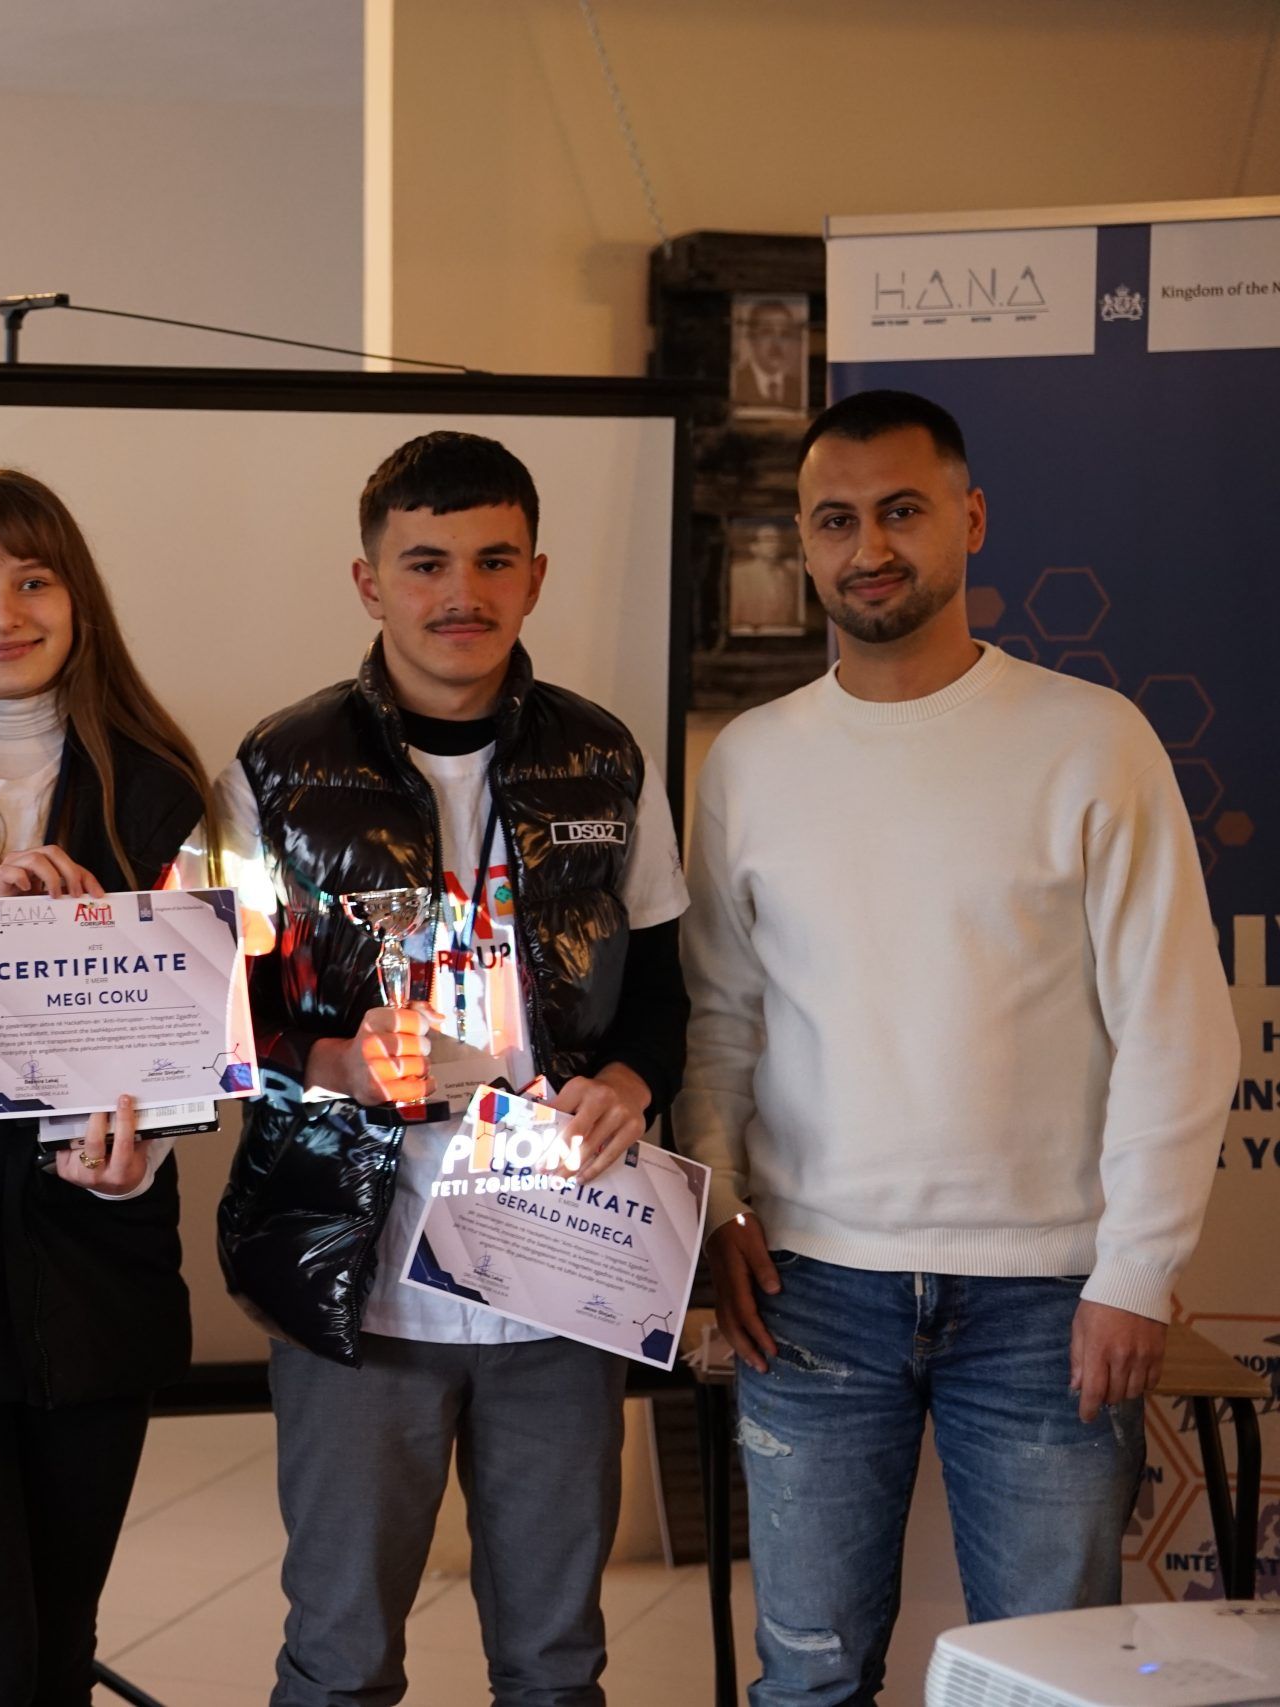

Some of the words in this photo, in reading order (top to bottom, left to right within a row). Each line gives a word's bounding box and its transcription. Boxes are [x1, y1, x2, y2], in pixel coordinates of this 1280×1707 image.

[1161, 283, 1224, 302] Kingdom
[1227, 281, 1243, 296] of
[1246, 281, 1269, 296] the
[74, 903, 112, 925] ANTI
[47, 990, 92, 1007] MEGI
[99, 988, 149, 1005] COKU
[497, 1192, 561, 1223] GERALD
[566, 1215, 633, 1248] NDRECA
